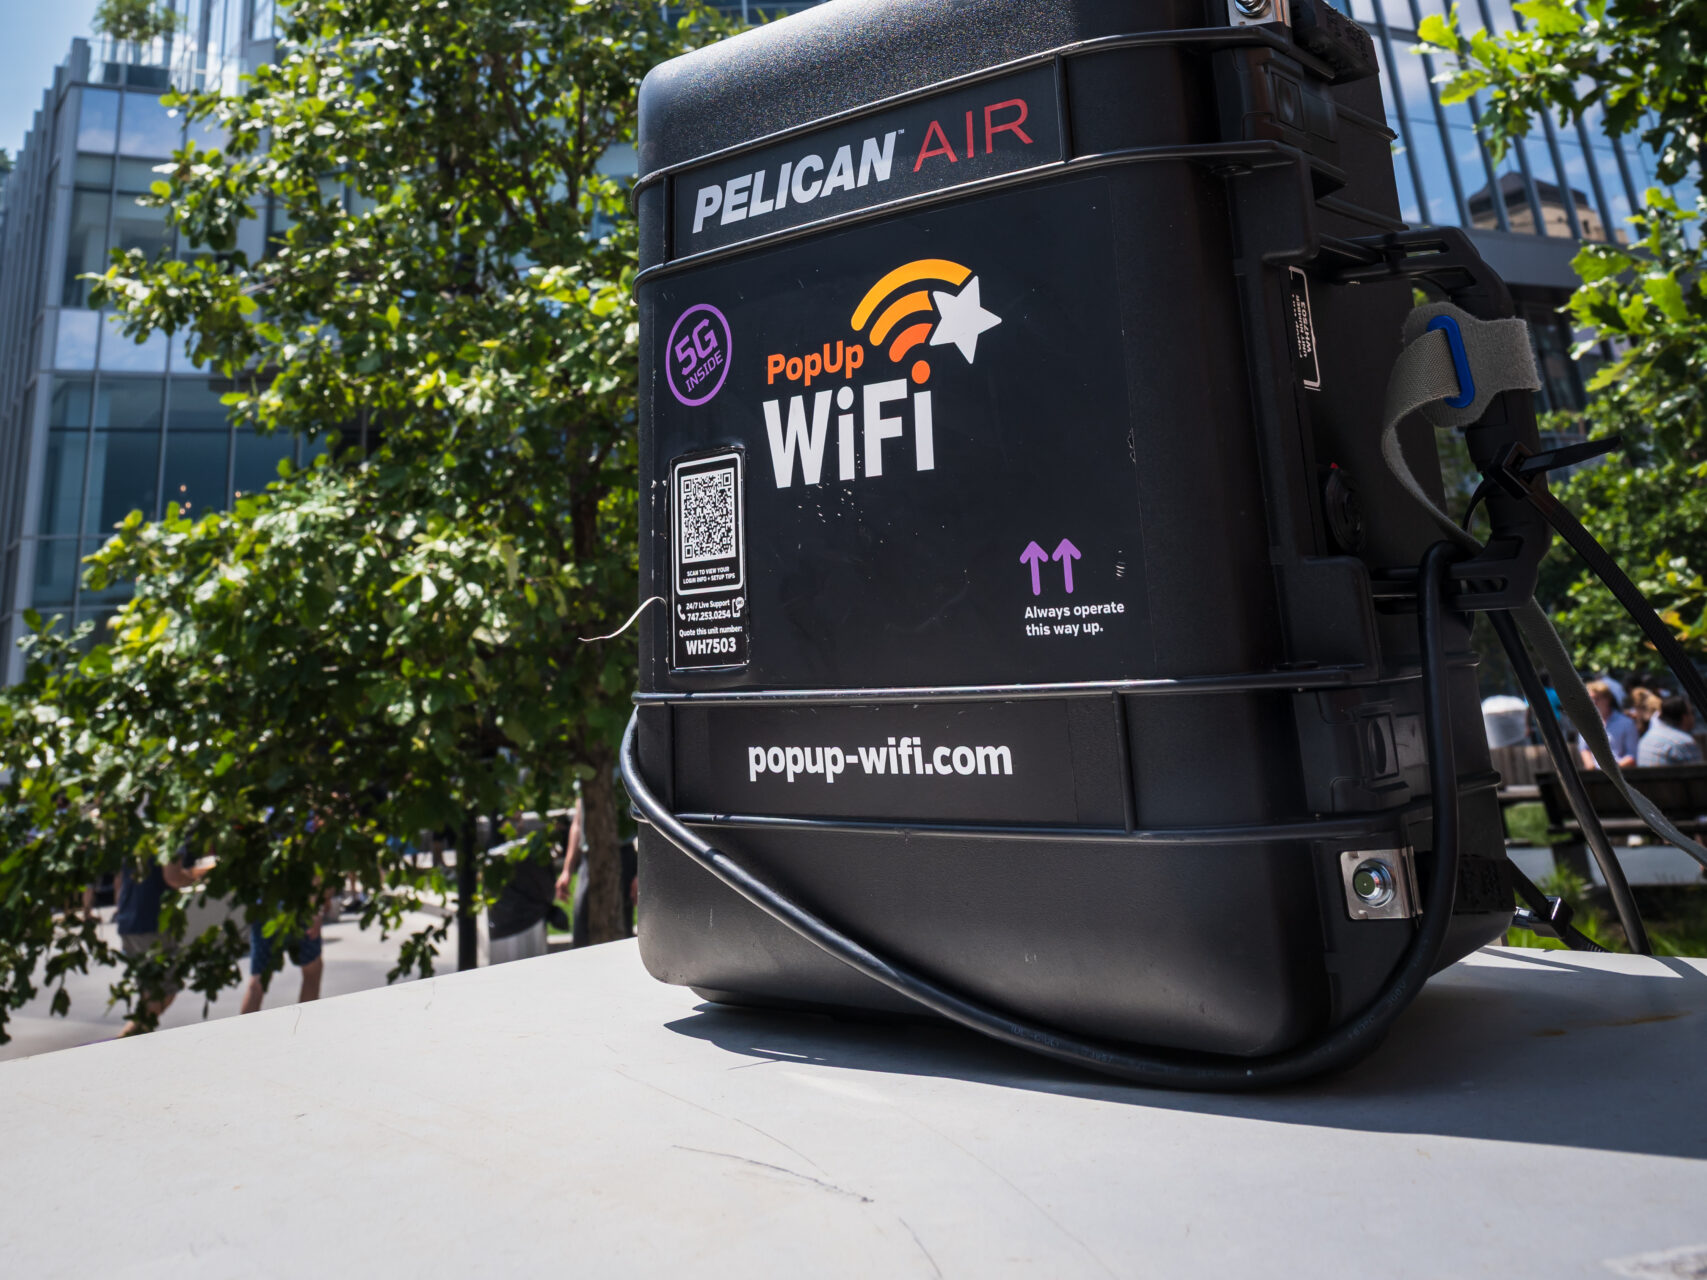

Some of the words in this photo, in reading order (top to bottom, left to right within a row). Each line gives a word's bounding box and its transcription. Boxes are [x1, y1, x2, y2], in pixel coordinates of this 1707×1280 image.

[913, 98, 1034, 173] AIR
[674, 318, 719, 376] 5G
[684, 349, 724, 393] INSIDE
[767, 340, 865, 387] PopUp
[762, 360, 935, 489] WiFi
[725, 572, 736, 580] TIPS
[686, 602, 698, 610] 24/7
[698, 601, 709, 609] Live
[709, 600, 730, 609] Support
[1024, 605, 1071, 620] Always
[1073, 601, 1125, 618] operate
[687, 609, 731, 622] 747.253.0254
[679, 629, 696, 638] Quote
[696, 627, 707, 636] this
[707, 626, 719, 635] unit
[719, 625, 743, 634] number:
[1025, 623, 1051, 636] this
[1053, 624, 1080, 637] way
[1083, 622, 1104, 636] up.
[685, 636, 737, 655] WH7503
[748, 736, 1014, 784] popup-wifi.com
